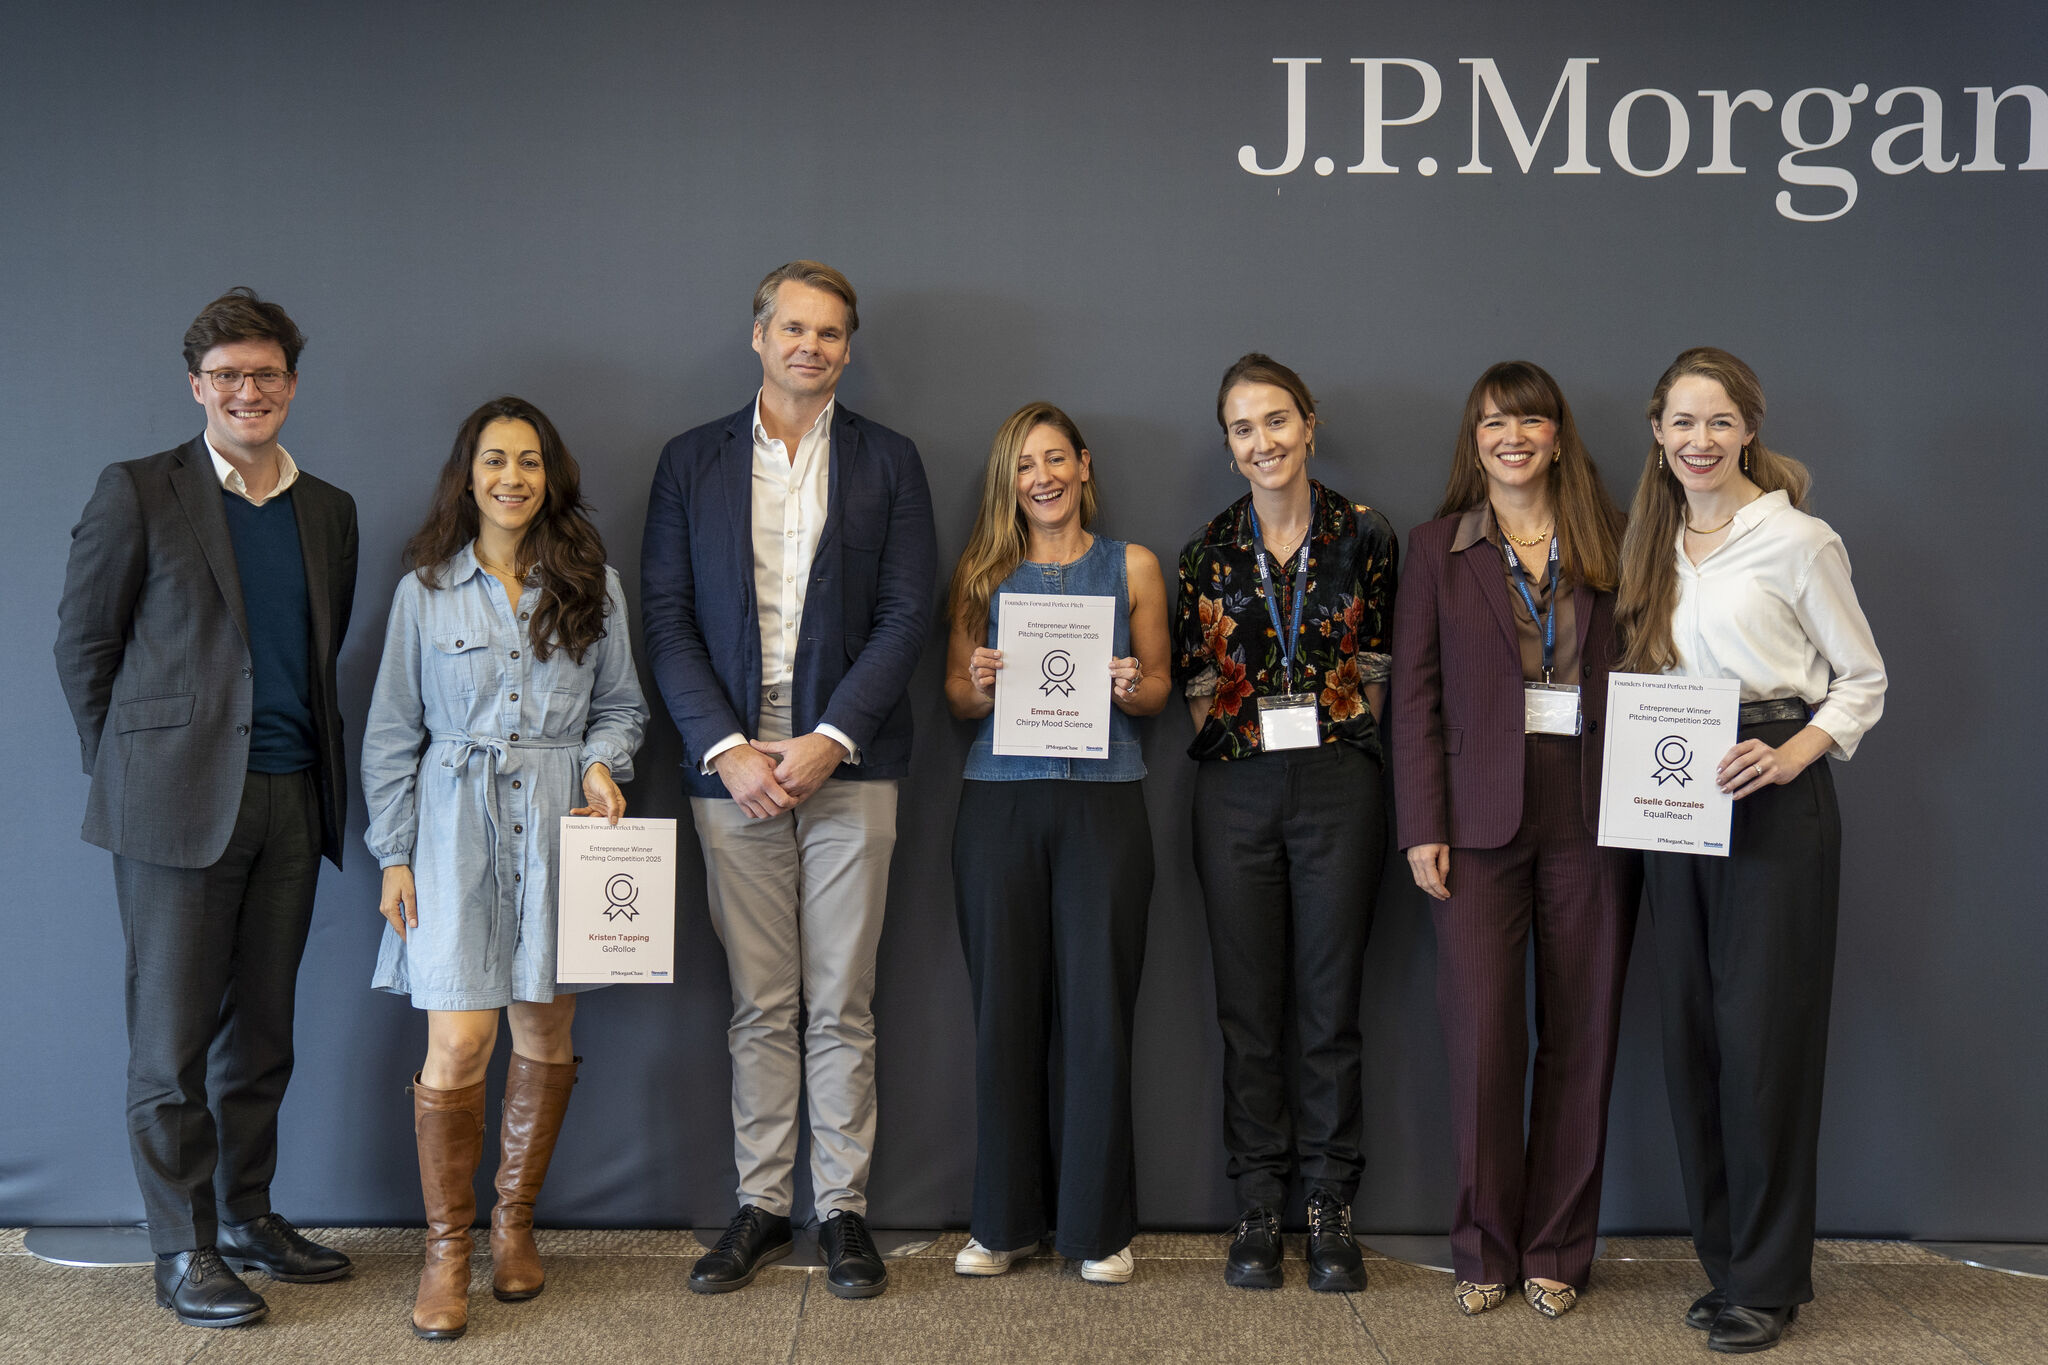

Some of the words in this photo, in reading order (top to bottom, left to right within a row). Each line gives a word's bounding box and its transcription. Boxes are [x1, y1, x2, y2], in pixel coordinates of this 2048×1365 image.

[1238, 57, 2048, 222] J.P.Morgan
[1027, 621, 1068, 630] Entrepreneur
[1018, 630, 1043, 639] Pitching
[1044, 631, 1082, 640] Competition
[1083, 632, 1100, 640] 2025
[1031, 707, 1055, 716] Emma
[1056, 709, 1080, 717] Grace
[1639, 704, 1685, 713] Entrepreneur
[1686, 707, 1711, 715] Winner
[1016, 718, 1041, 728] Chirpy
[1041, 720, 1063, 728] Mood
[1064, 720, 1093, 729] Science
[1628, 713, 1657, 723] Pitching
[1658, 715, 1702, 725] Competition
[1702, 718, 1721, 726] 2025
[1633, 796, 1663, 806] Giselle
[1664, 799, 1705, 809] Gonzales
[1643, 809, 1693, 820] EqualReach
[589, 845, 630, 853] Entrepreneur
[580, 854, 606, 862] Pitching
[606, 855, 645, 863] Competition
[588, 933, 617, 941] Kristen
[618, 934, 650, 942] Tapping
[602, 945, 636, 953] GoRolloe
